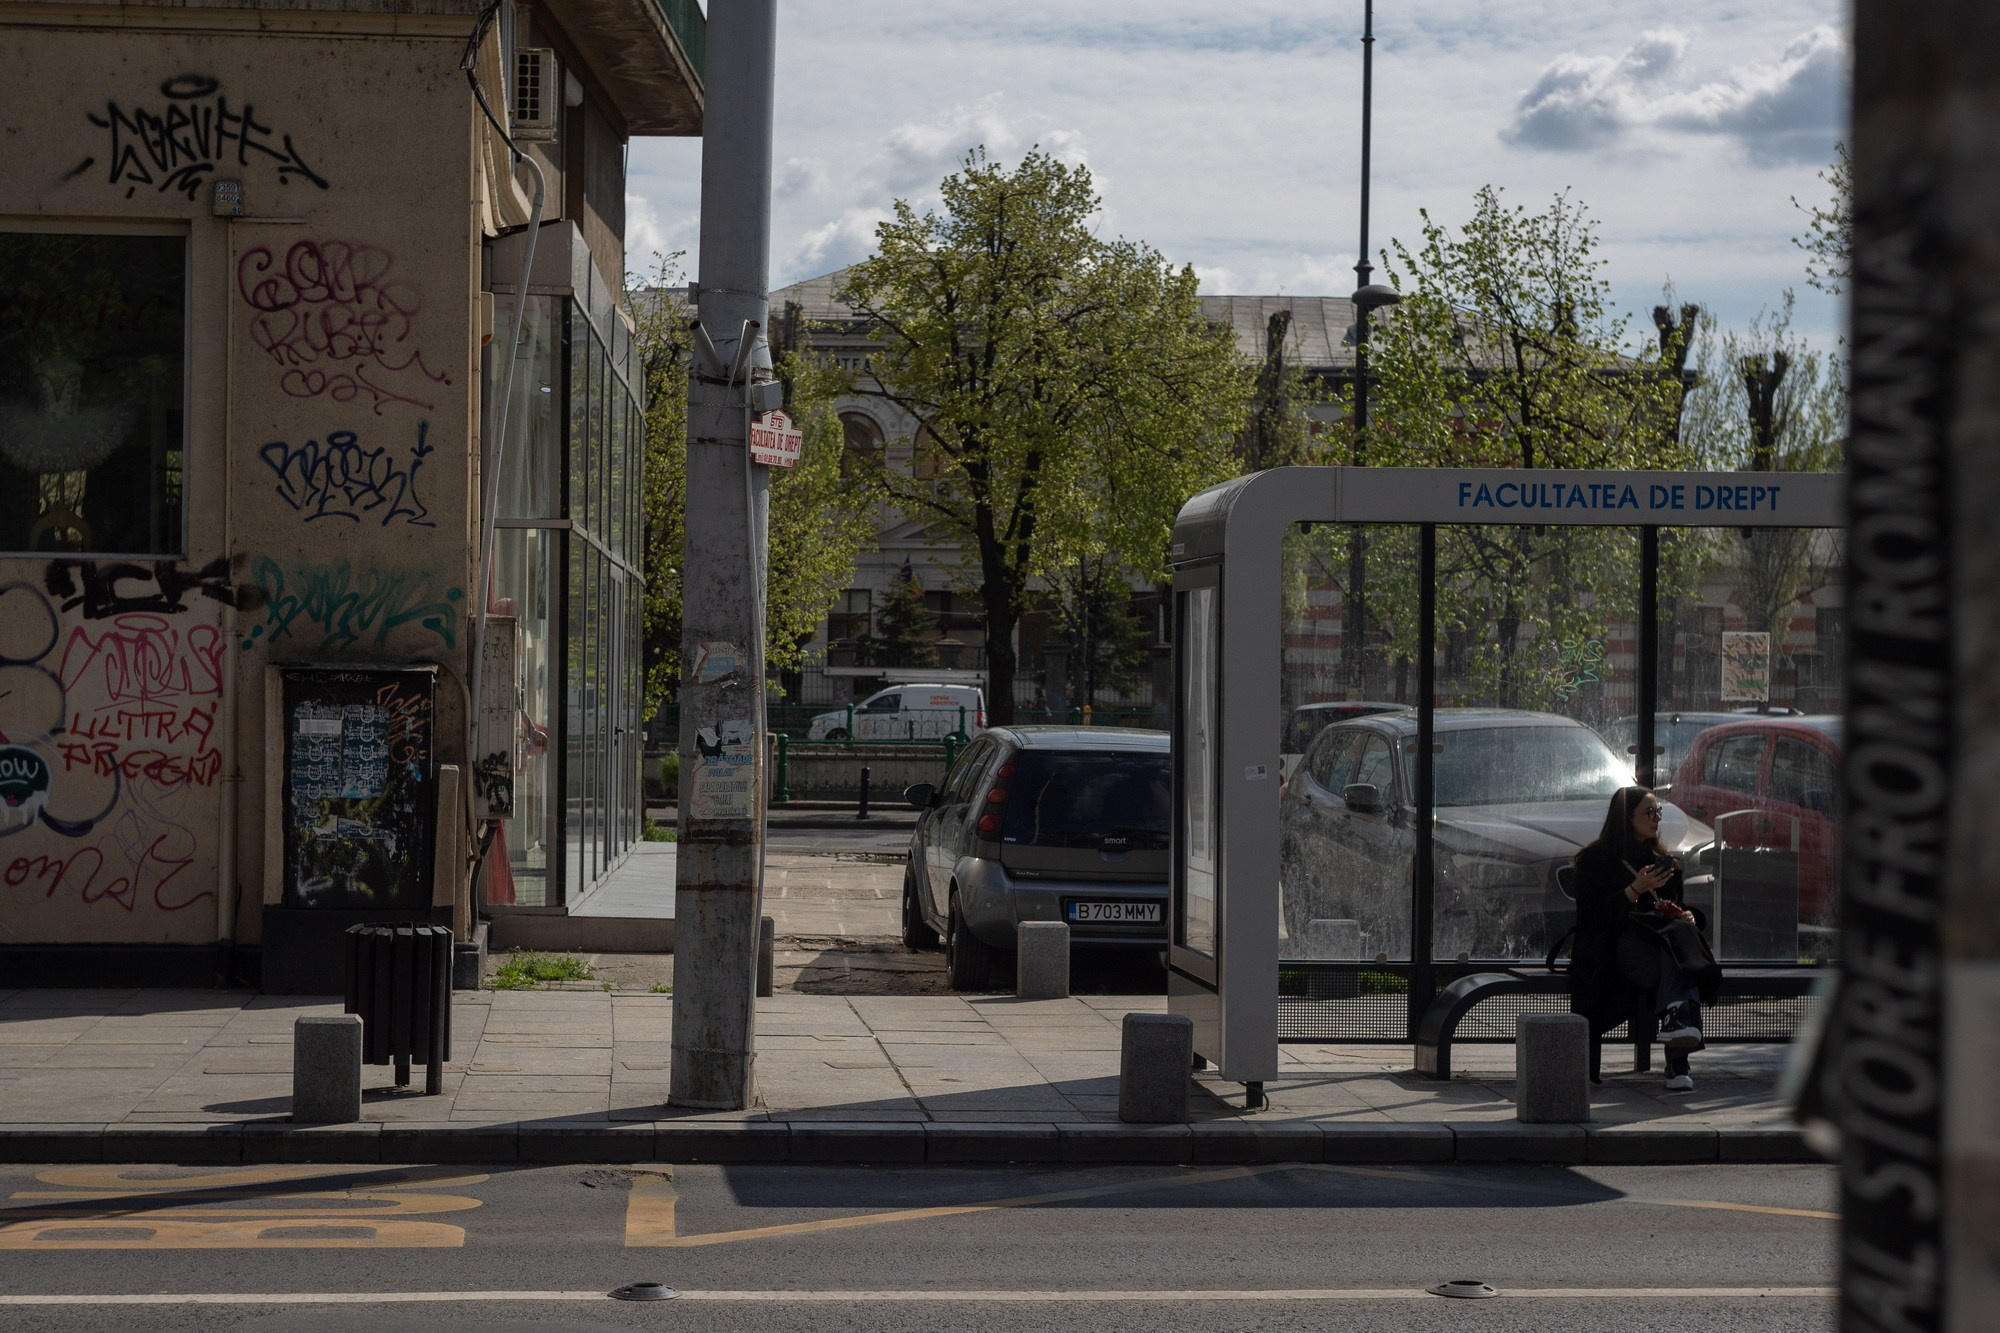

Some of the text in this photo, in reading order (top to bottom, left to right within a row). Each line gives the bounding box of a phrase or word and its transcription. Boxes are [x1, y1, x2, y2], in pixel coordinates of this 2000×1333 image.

[770, 416, 784, 430] STB
[1850, 222, 1948, 643] ROMANIA
[751, 428, 802, 454] FACULTATEA DE DREPT
[1458, 482, 1781, 511] FACULTATEA DE DREPT
[1845, 657, 1951, 918] FROM
[1104, 836, 1128, 845] smart
[1078, 904, 1157, 920] B 703 MMY
[1843, 928, 1943, 1221] STORE
